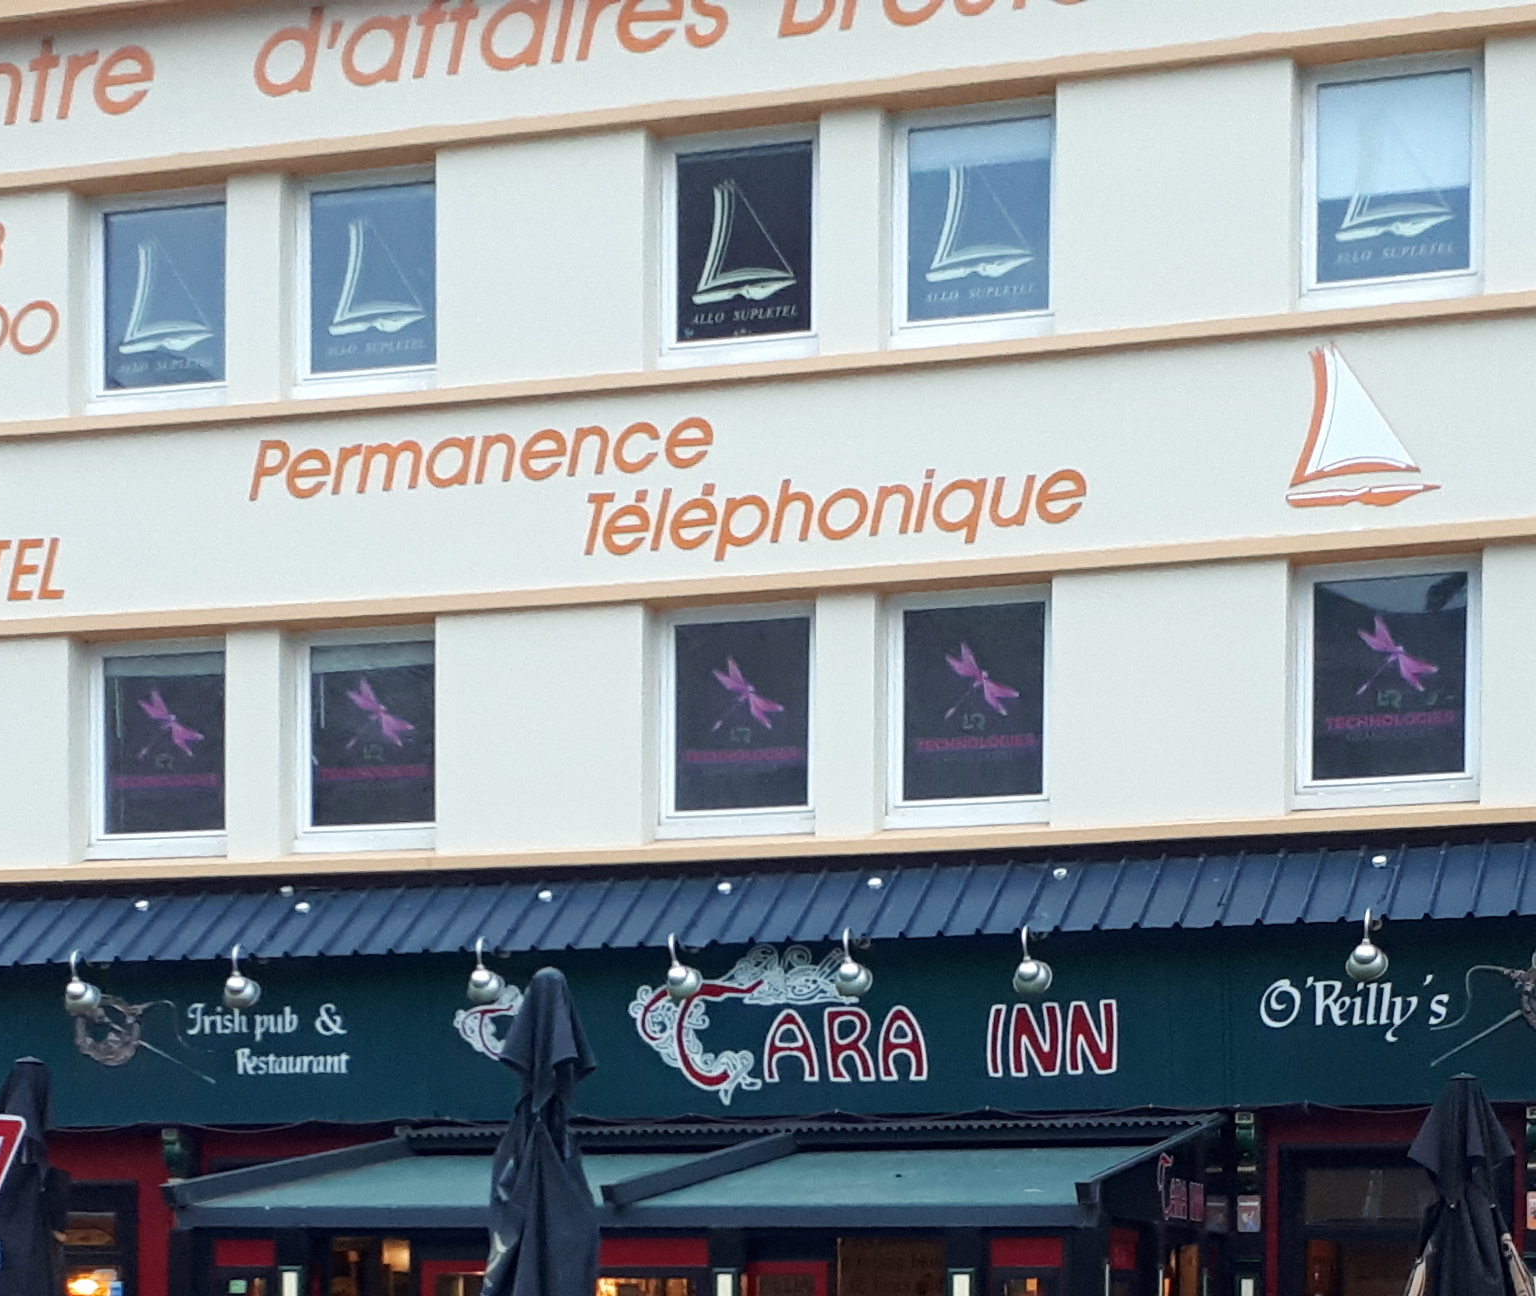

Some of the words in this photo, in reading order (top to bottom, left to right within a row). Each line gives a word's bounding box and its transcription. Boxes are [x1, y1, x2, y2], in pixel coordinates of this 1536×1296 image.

[253, 0, 730, 97] d'affaires
[691, 312, 725, 325] ALLO
[249, 415, 715, 501] Permanence
[583, 466, 1087, 562] Téléphonique
[186, 1002, 250, 1035] Irish
[253, 1004, 300, 1043] pub
[314, 1002, 348, 1036] &
[986, 999, 1117, 1078] INN
[1259, 973, 1451, 1043] O'Reilly's
[233, 1047, 351, 1076] Restaurant
